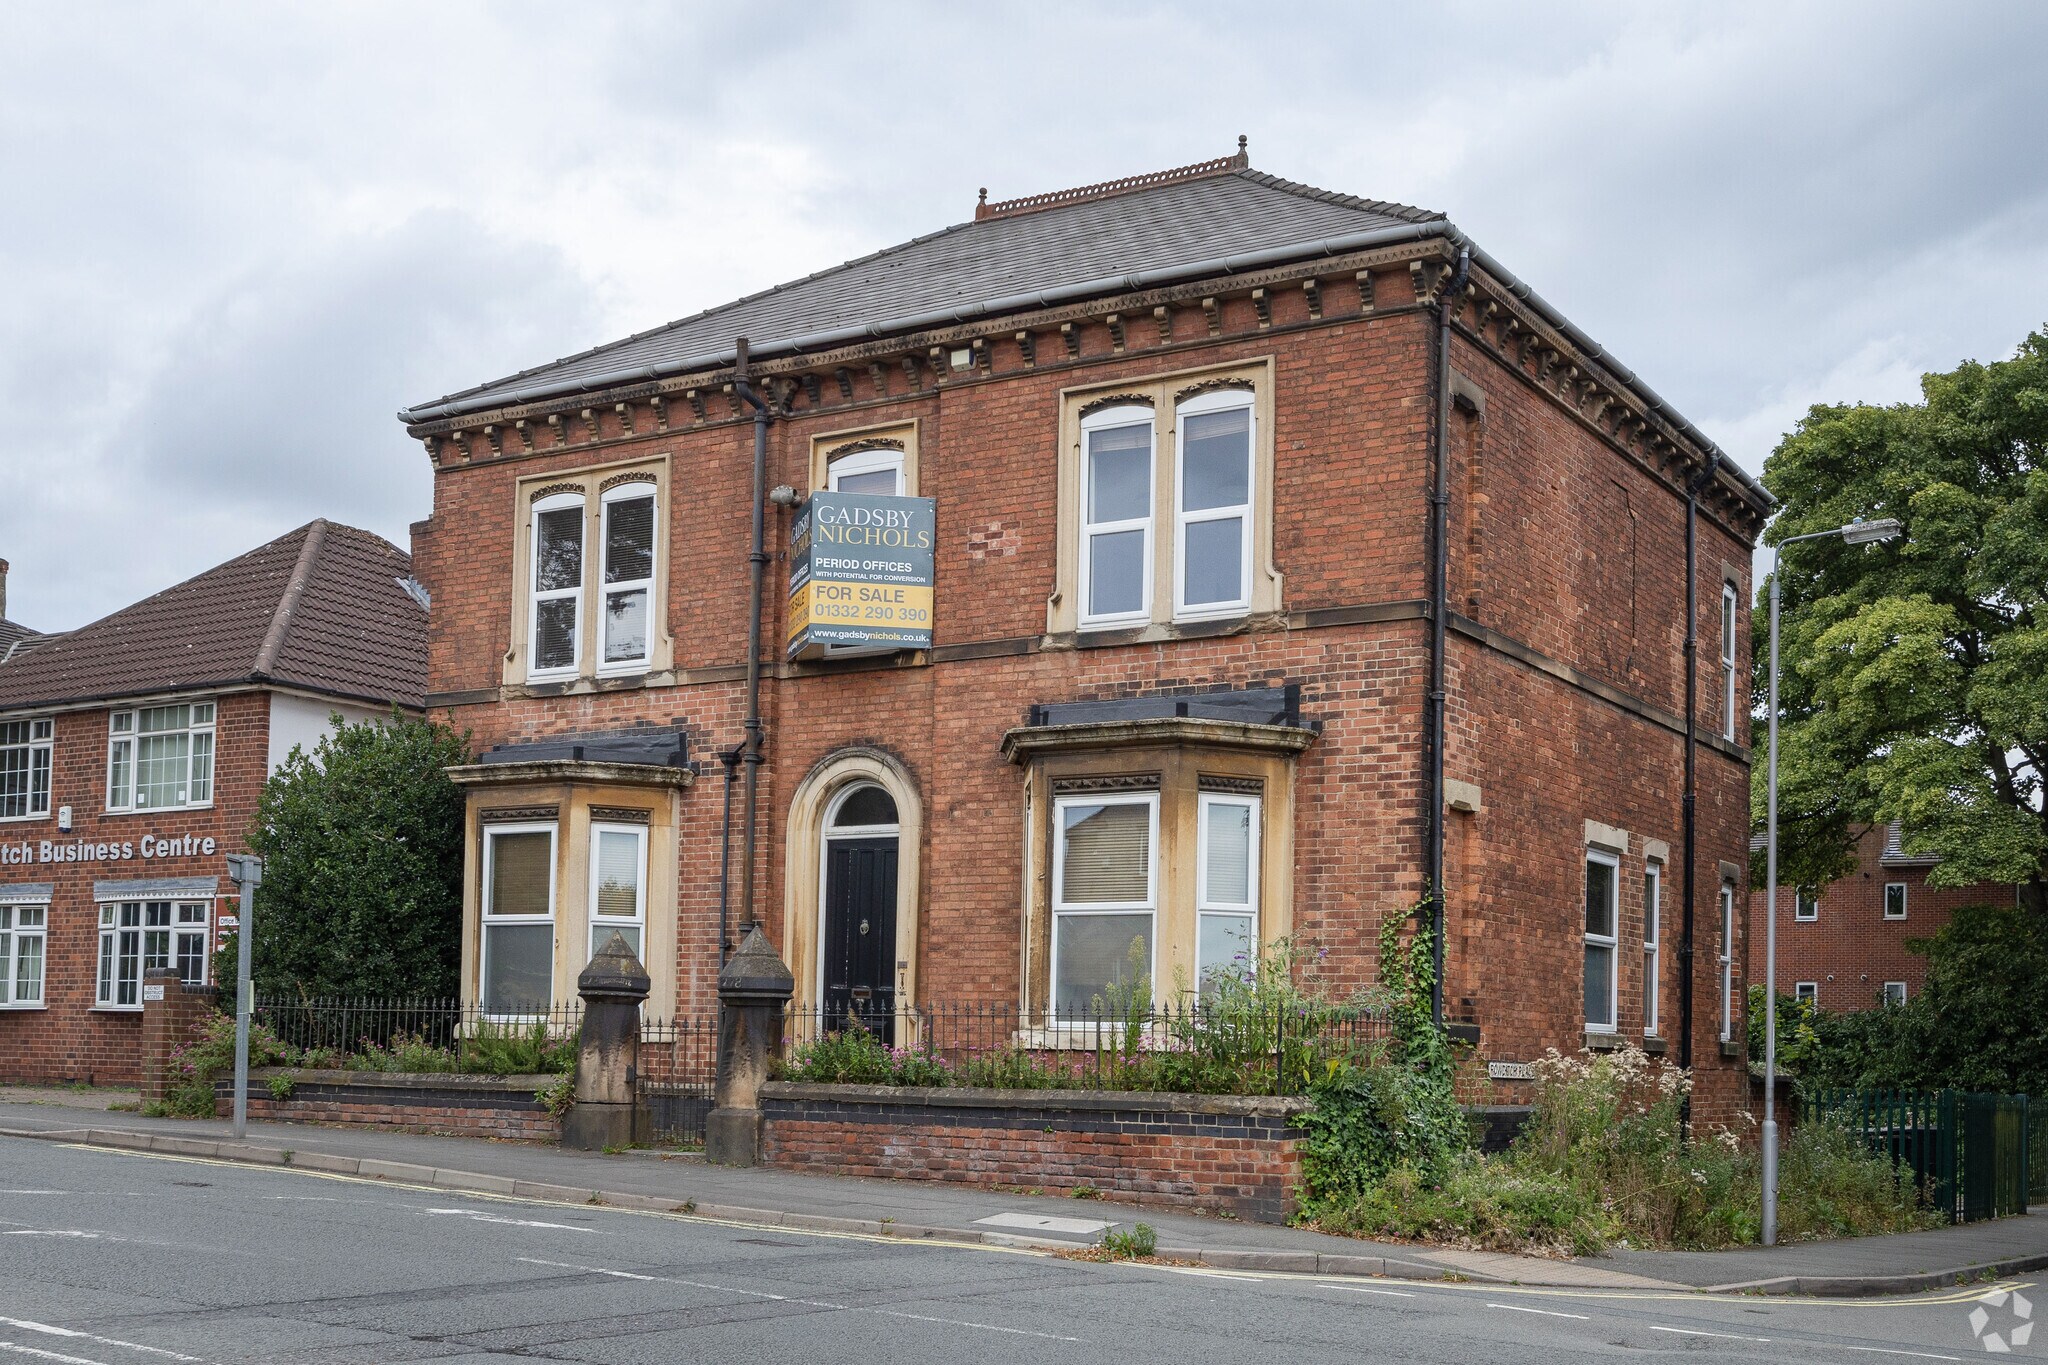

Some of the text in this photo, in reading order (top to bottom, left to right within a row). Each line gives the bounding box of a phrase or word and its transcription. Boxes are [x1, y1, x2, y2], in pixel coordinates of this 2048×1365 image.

[817, 505, 914, 528] GADSBY
[818, 525, 930, 549] NICHOLS
[815, 558, 913, 573] PERIOD OFFICES
[833, 572, 868, 580] POTENTIAL
[869, 573, 883, 581] FOR
[884, 574, 926, 583] CONVERSION
[816, 585, 852, 601] FOR
[859, 587, 905, 604] SALE
[815, 603, 927, 621] 01332 290 390
[814, 630, 926, 643] www.gadsbynichols.co.uk
[39, 839, 134, 864] Business
[140, 833, 216, 859] Centre
